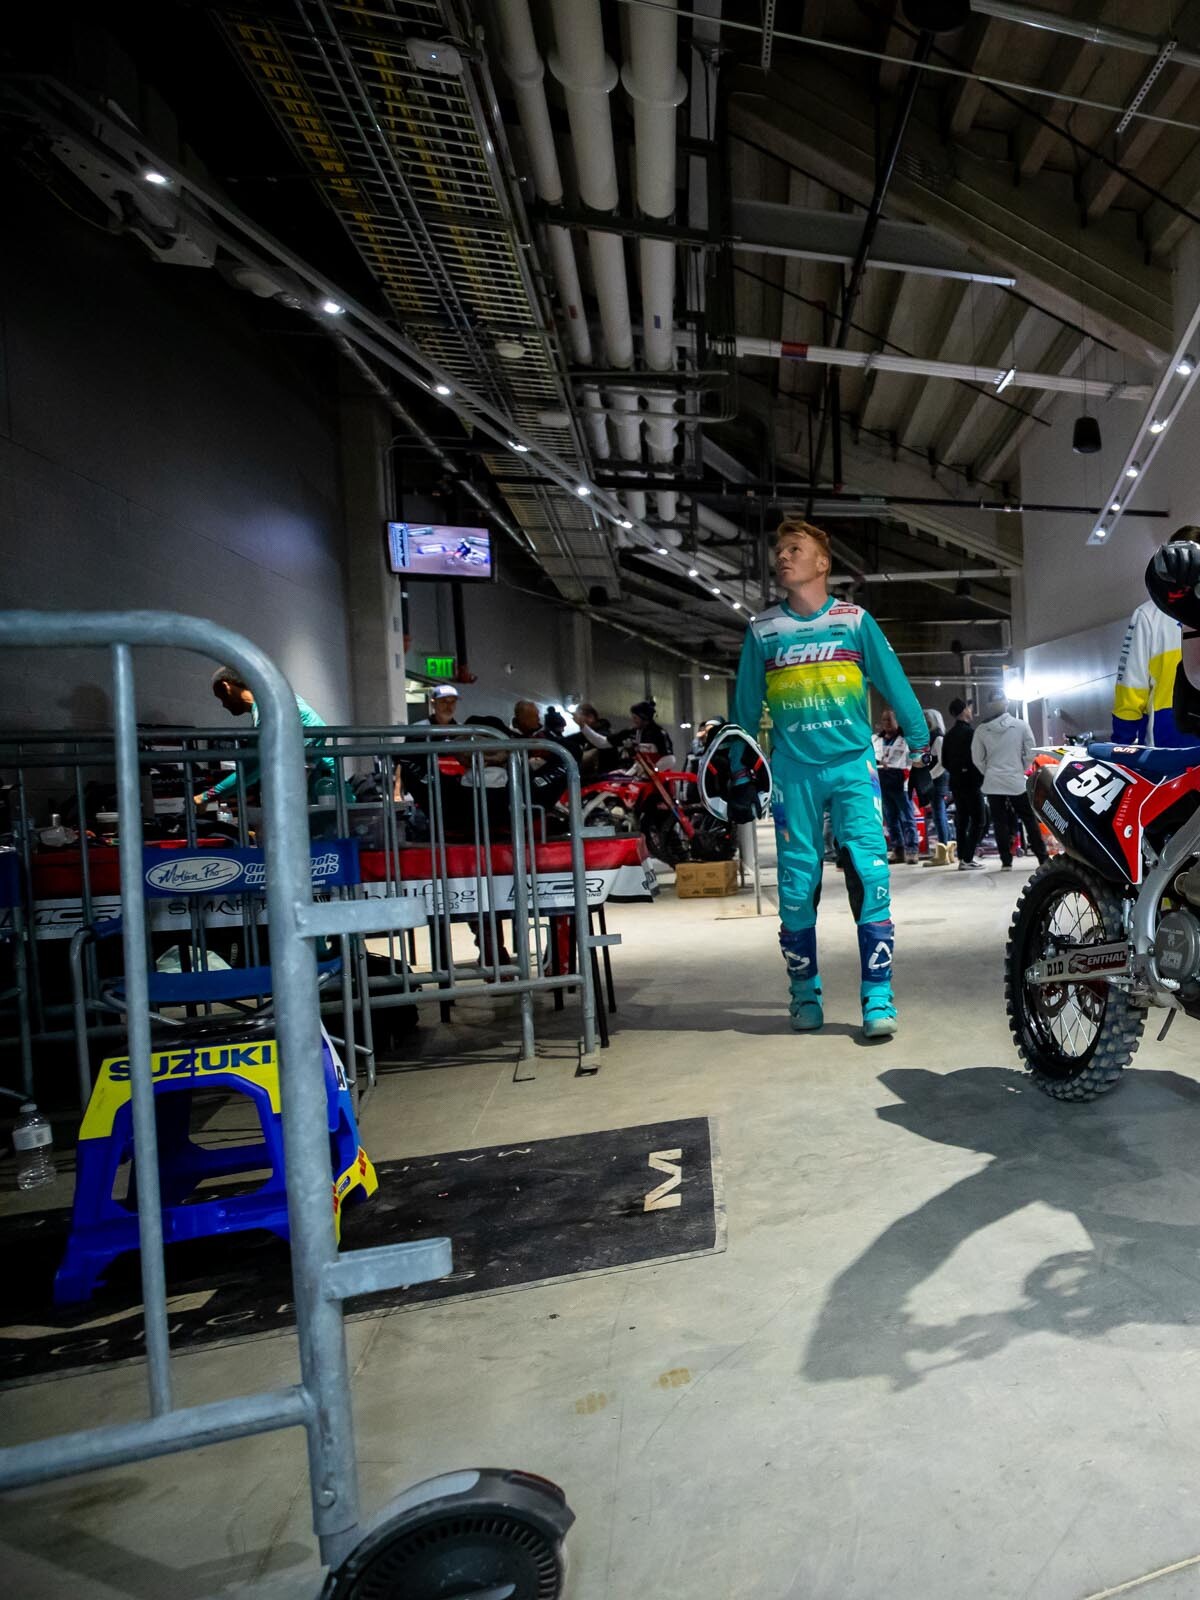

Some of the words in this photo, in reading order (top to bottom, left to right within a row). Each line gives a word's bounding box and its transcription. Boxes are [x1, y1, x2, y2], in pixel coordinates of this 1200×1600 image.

[775, 640, 844, 667] LEATT
[427, 659, 453, 676] EXIT
[782, 694, 846, 711] bullfrog
[801, 719, 854, 732] HONDA
[1066, 763, 1126, 816] 54
[158, 864, 199, 884] Motion
[201, 862, 232, 877] Pro
[1067, 952, 1129, 974] RENTHAL
[109, 1045, 271, 1082] SUZUKI
